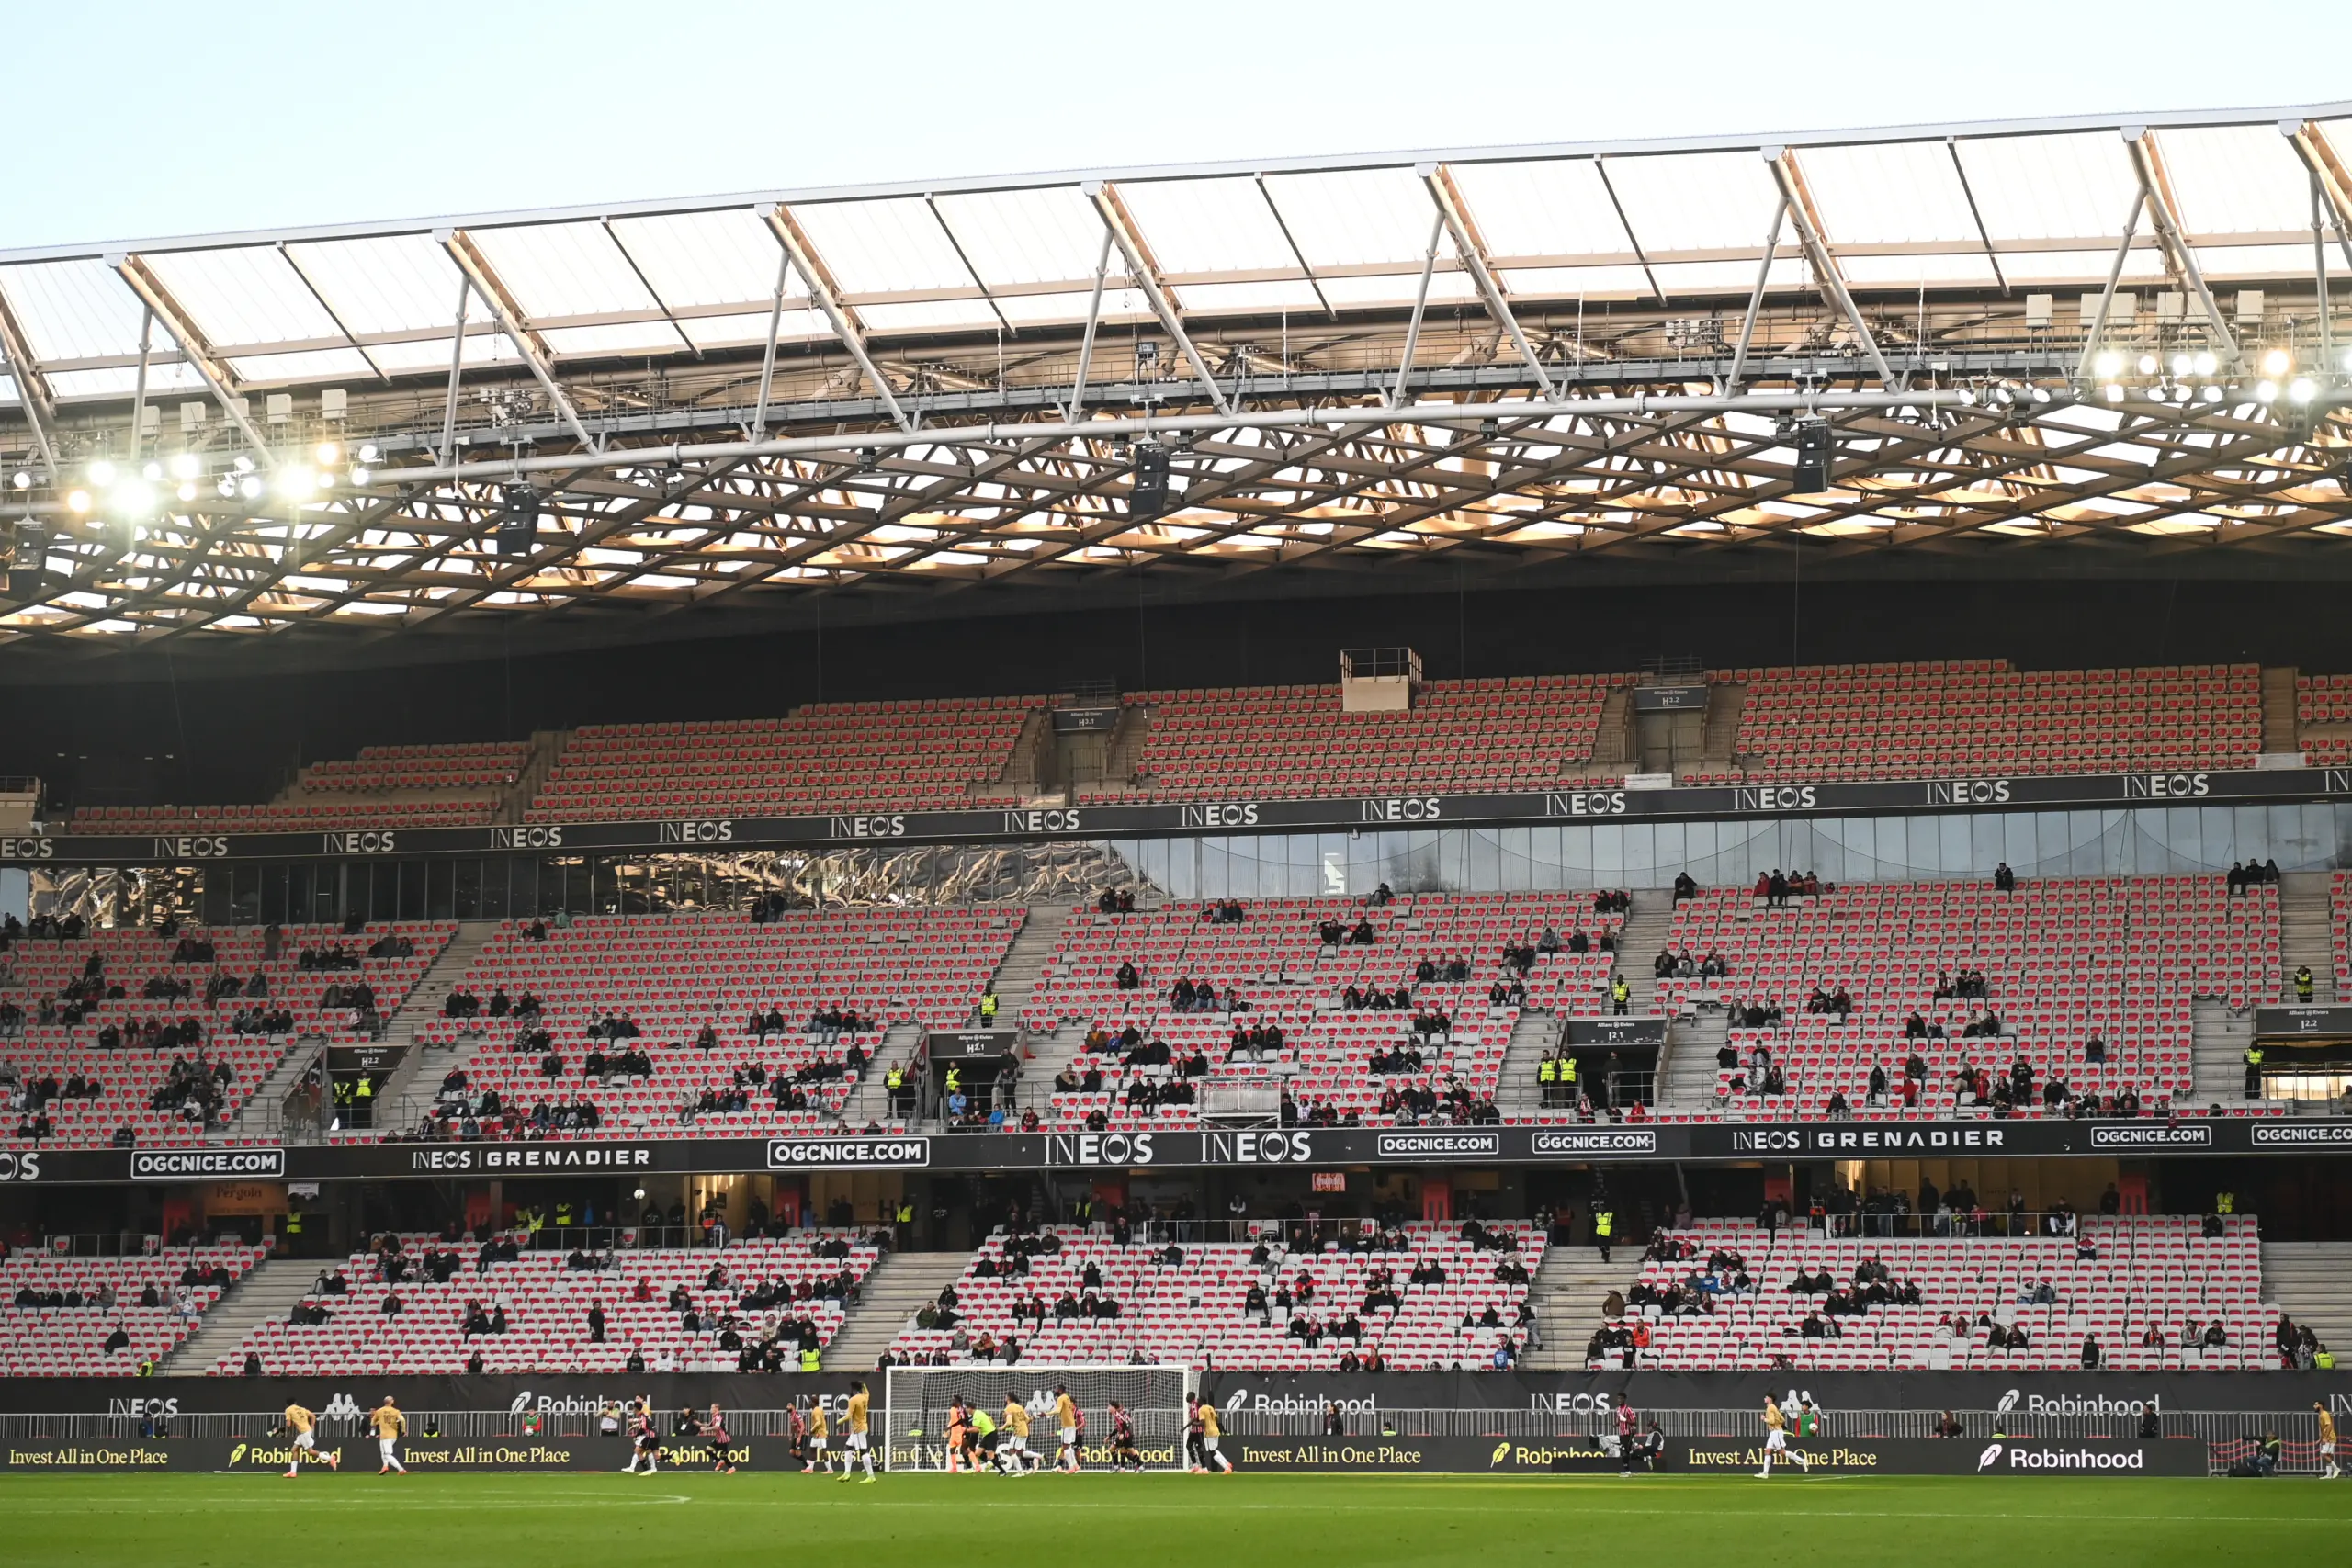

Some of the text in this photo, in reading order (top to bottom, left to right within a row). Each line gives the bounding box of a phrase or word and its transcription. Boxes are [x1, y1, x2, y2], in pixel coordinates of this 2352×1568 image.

[1926, 780, 2010, 804] INEOS
[2122, 774, 2210, 798] INEOS
[1545, 792, 1626, 816] INEOS
[1734, 786, 1816, 810] INEOS
[1003, 809, 1080, 832] INEOS
[1181, 803, 1259, 827] INEOS
[1362, 798, 1441, 822] INEOS
[659, 820, 733, 842] INEOS
[830, 815, 905, 838] INEOS
[154, 837, 228, 858] INEOS
[323, 831, 395, 853] INEOS
[490, 827, 563, 849] INEOS
[1200, 1131, 1312, 1163] INEOS
[1383, 1136, 1493, 1152] OGCNICE.COM
[1537, 1135, 1650, 1149] OGCNICE.COM
[1733, 1130, 2005, 1151] INEOS GRENADIER
[2096, 1129, 2205, 1143] OGCNICE.COM
[412, 1149, 650, 1169] INEOS GRENADIER
[775, 1143, 922, 1162] OGCNICE.COM
[1044, 1133, 1154, 1165] INEOS
[138, 1155, 277, 1172] OGCNICE.COM
[109, 1397, 178, 1418] INEOS
[795, 1393, 850, 1415] INEO
[1254, 1393, 1375, 1415] Robinhood
[1531, 1393, 1611, 1416] INEOS
[2028, 1393, 2160, 1416] Robinhood
[9, 1448, 168, 1464] Invest All in One Place
[403, 1446, 570, 1463] Invest All in One Place
[1242, 1445, 1421, 1463] Invest All in One Place
[1689, 1448, 1740, 1465] Invest
[1831, 1448, 1877, 1465] Place
[2010, 1448, 2143, 1469] Robinhood
